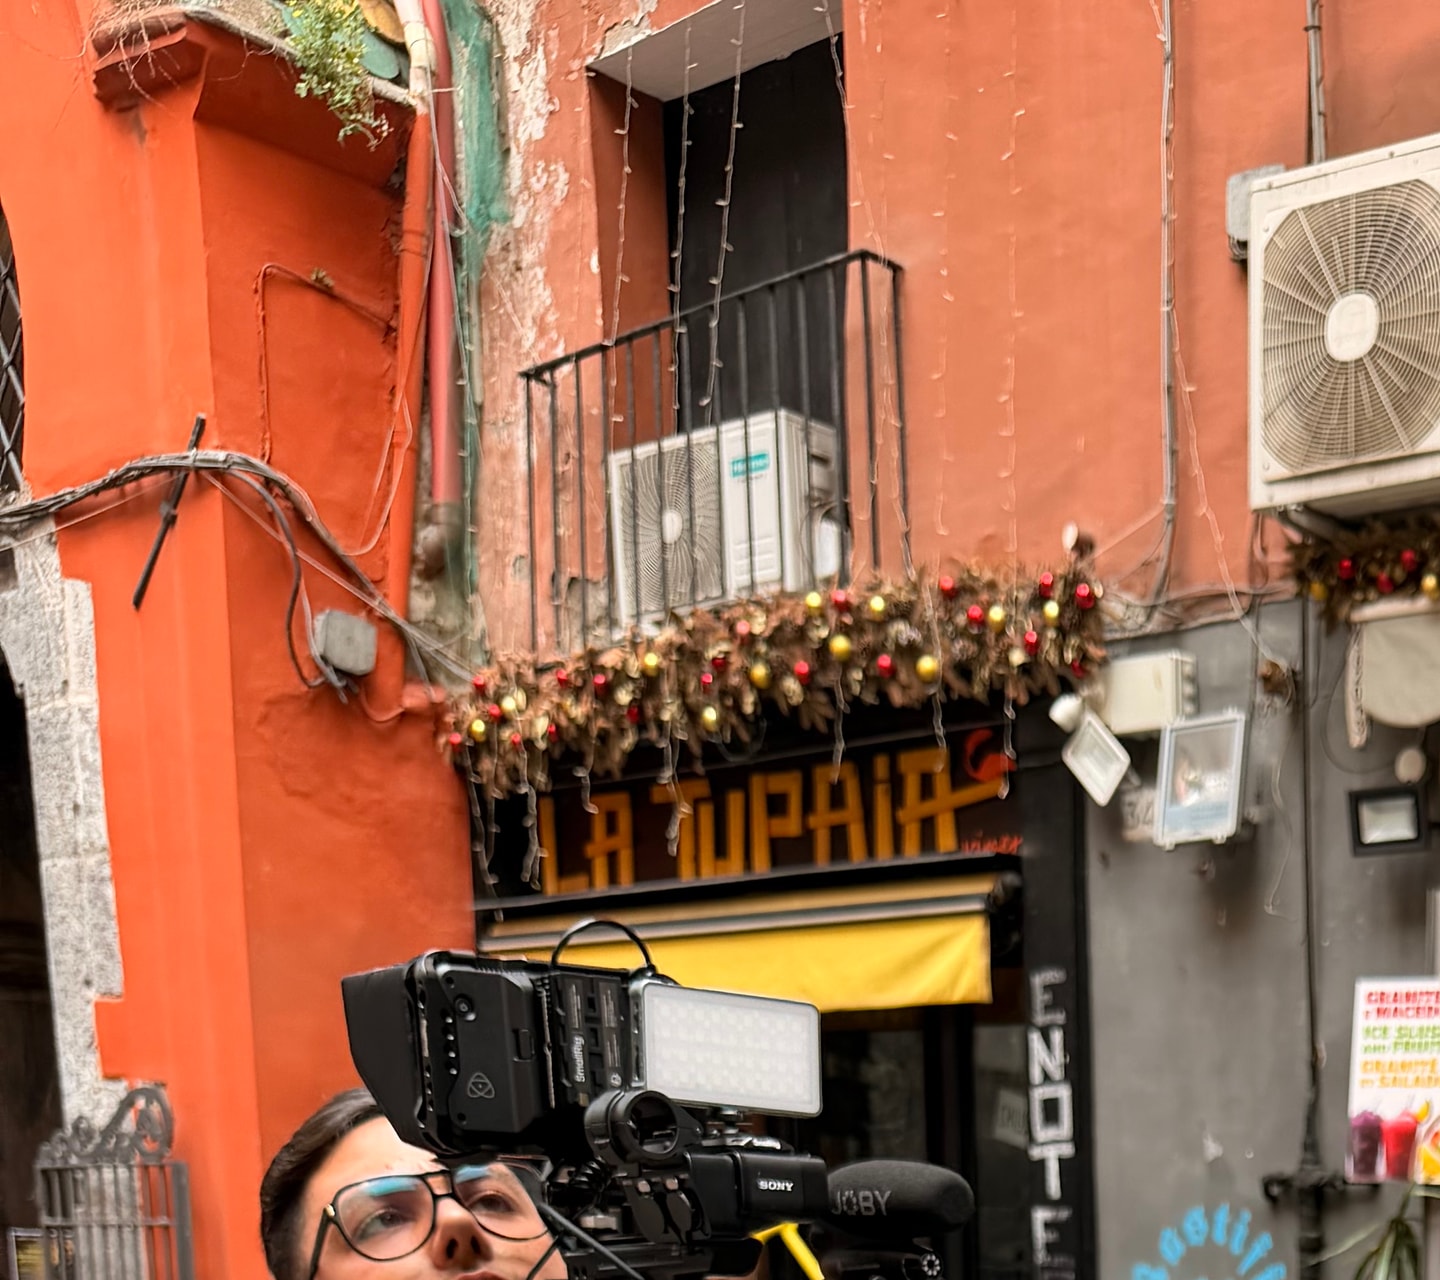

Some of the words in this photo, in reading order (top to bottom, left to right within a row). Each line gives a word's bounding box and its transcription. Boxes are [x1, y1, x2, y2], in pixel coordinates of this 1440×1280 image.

[539, 791, 634, 897] LA
[757, 1177, 795, 1192] SONY
[831, 1190, 892, 1216] JOBY
